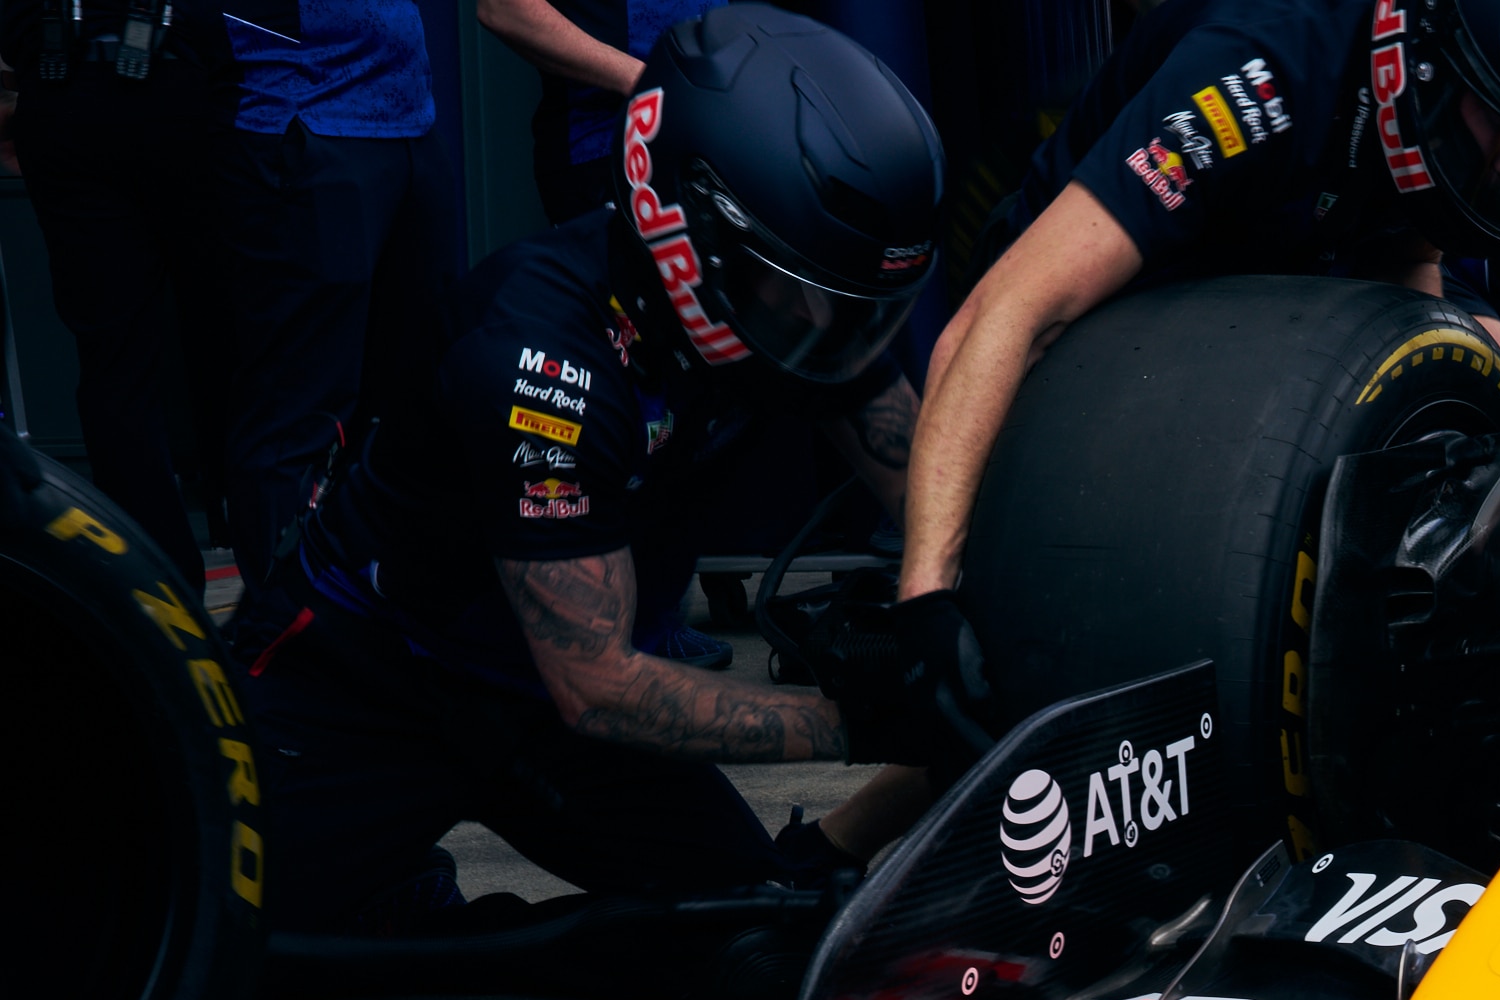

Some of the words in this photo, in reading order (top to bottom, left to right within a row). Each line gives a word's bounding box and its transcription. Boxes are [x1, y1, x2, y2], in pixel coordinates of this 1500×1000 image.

[1202, 94, 1239, 150] PIRELLI
[1220, 74, 1257, 107] Hard
[1240, 102, 1270, 144] Rock
[1240, 58, 1293, 134] Mobil
[1371, 41, 1436, 194] Bull
[623, 86, 689, 242] Red
[1125, 147, 1160, 188] Red
[1150, 173, 1187, 212] Bull
[646, 231, 753, 367] Bull
[513, 378, 552, 402] Hard
[551, 389, 587, 416] Rock
[518, 347, 592, 391] Mobil
[516, 411, 575, 440] PIRELLI
[519, 498, 555, 519] Red
[555, 495, 590, 519] Bull
[47, 506, 130, 556] P
[133, 581, 266, 909] ZERO
[1083, 735, 1195, 858] AT&T
[1304, 872, 1486, 954] VIS
